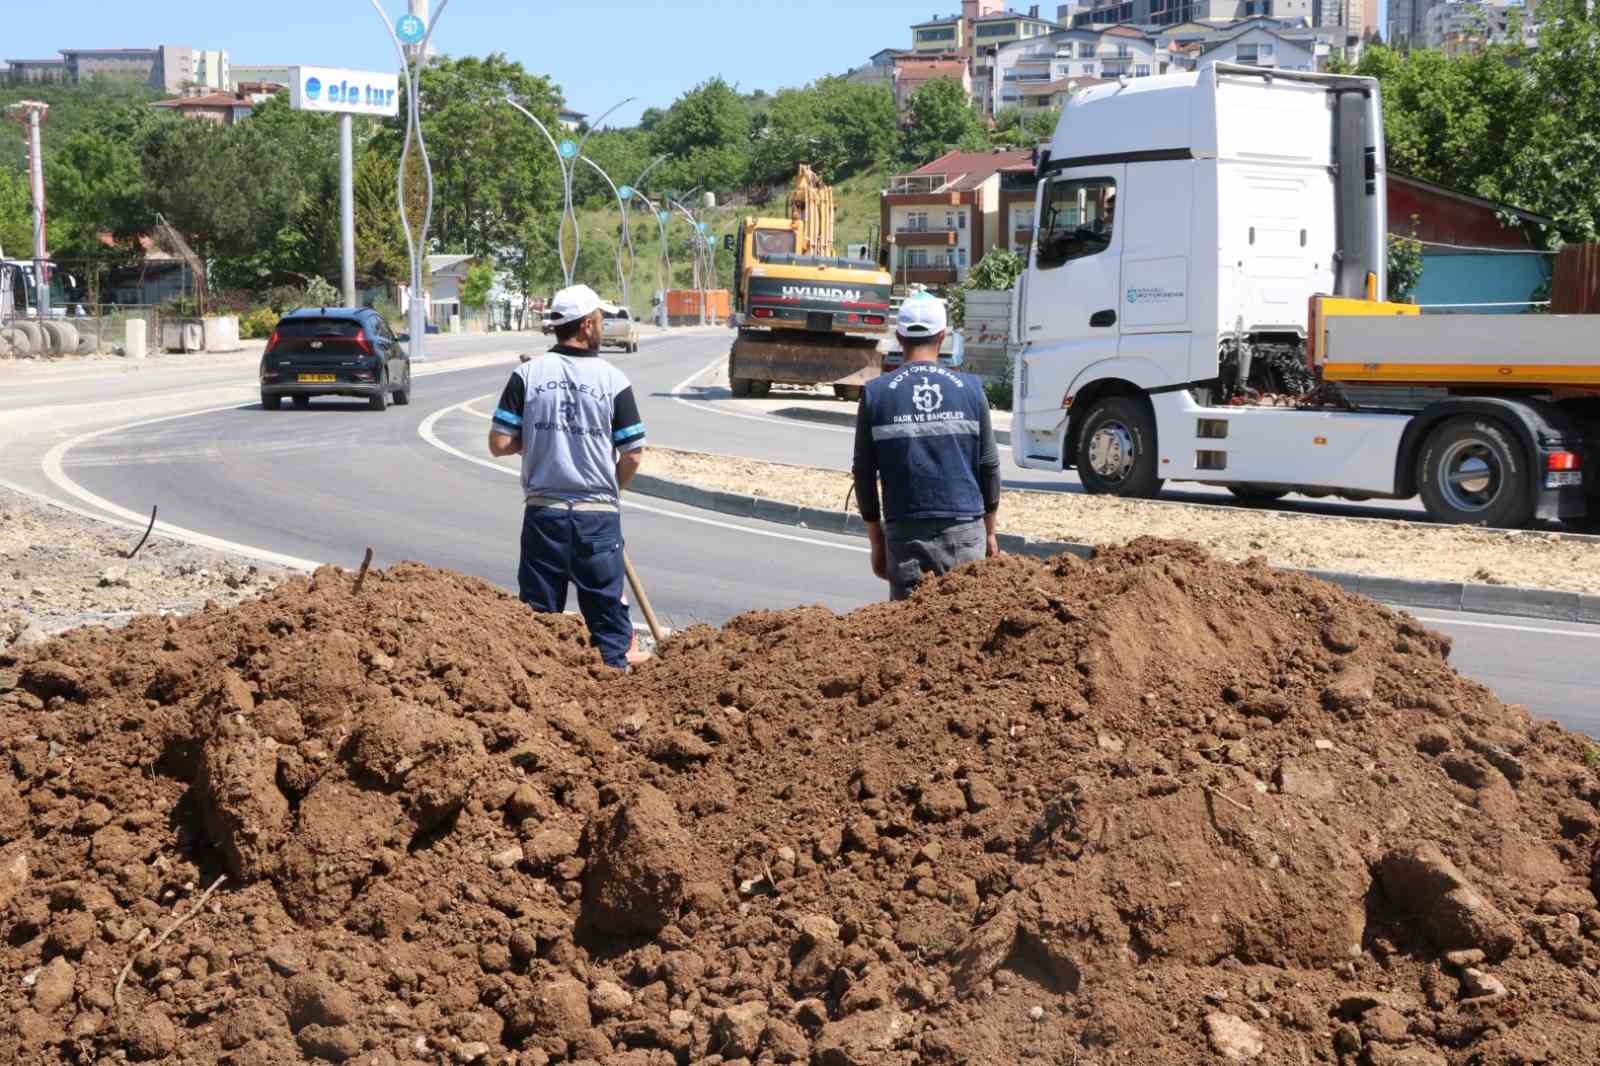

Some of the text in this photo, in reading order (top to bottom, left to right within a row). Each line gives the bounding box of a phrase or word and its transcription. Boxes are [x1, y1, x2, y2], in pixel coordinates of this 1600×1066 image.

[328, 80, 394, 106] efe tur
[782, 286, 861, 303] HYUNDAI
[914, 413, 925, 422] VE
